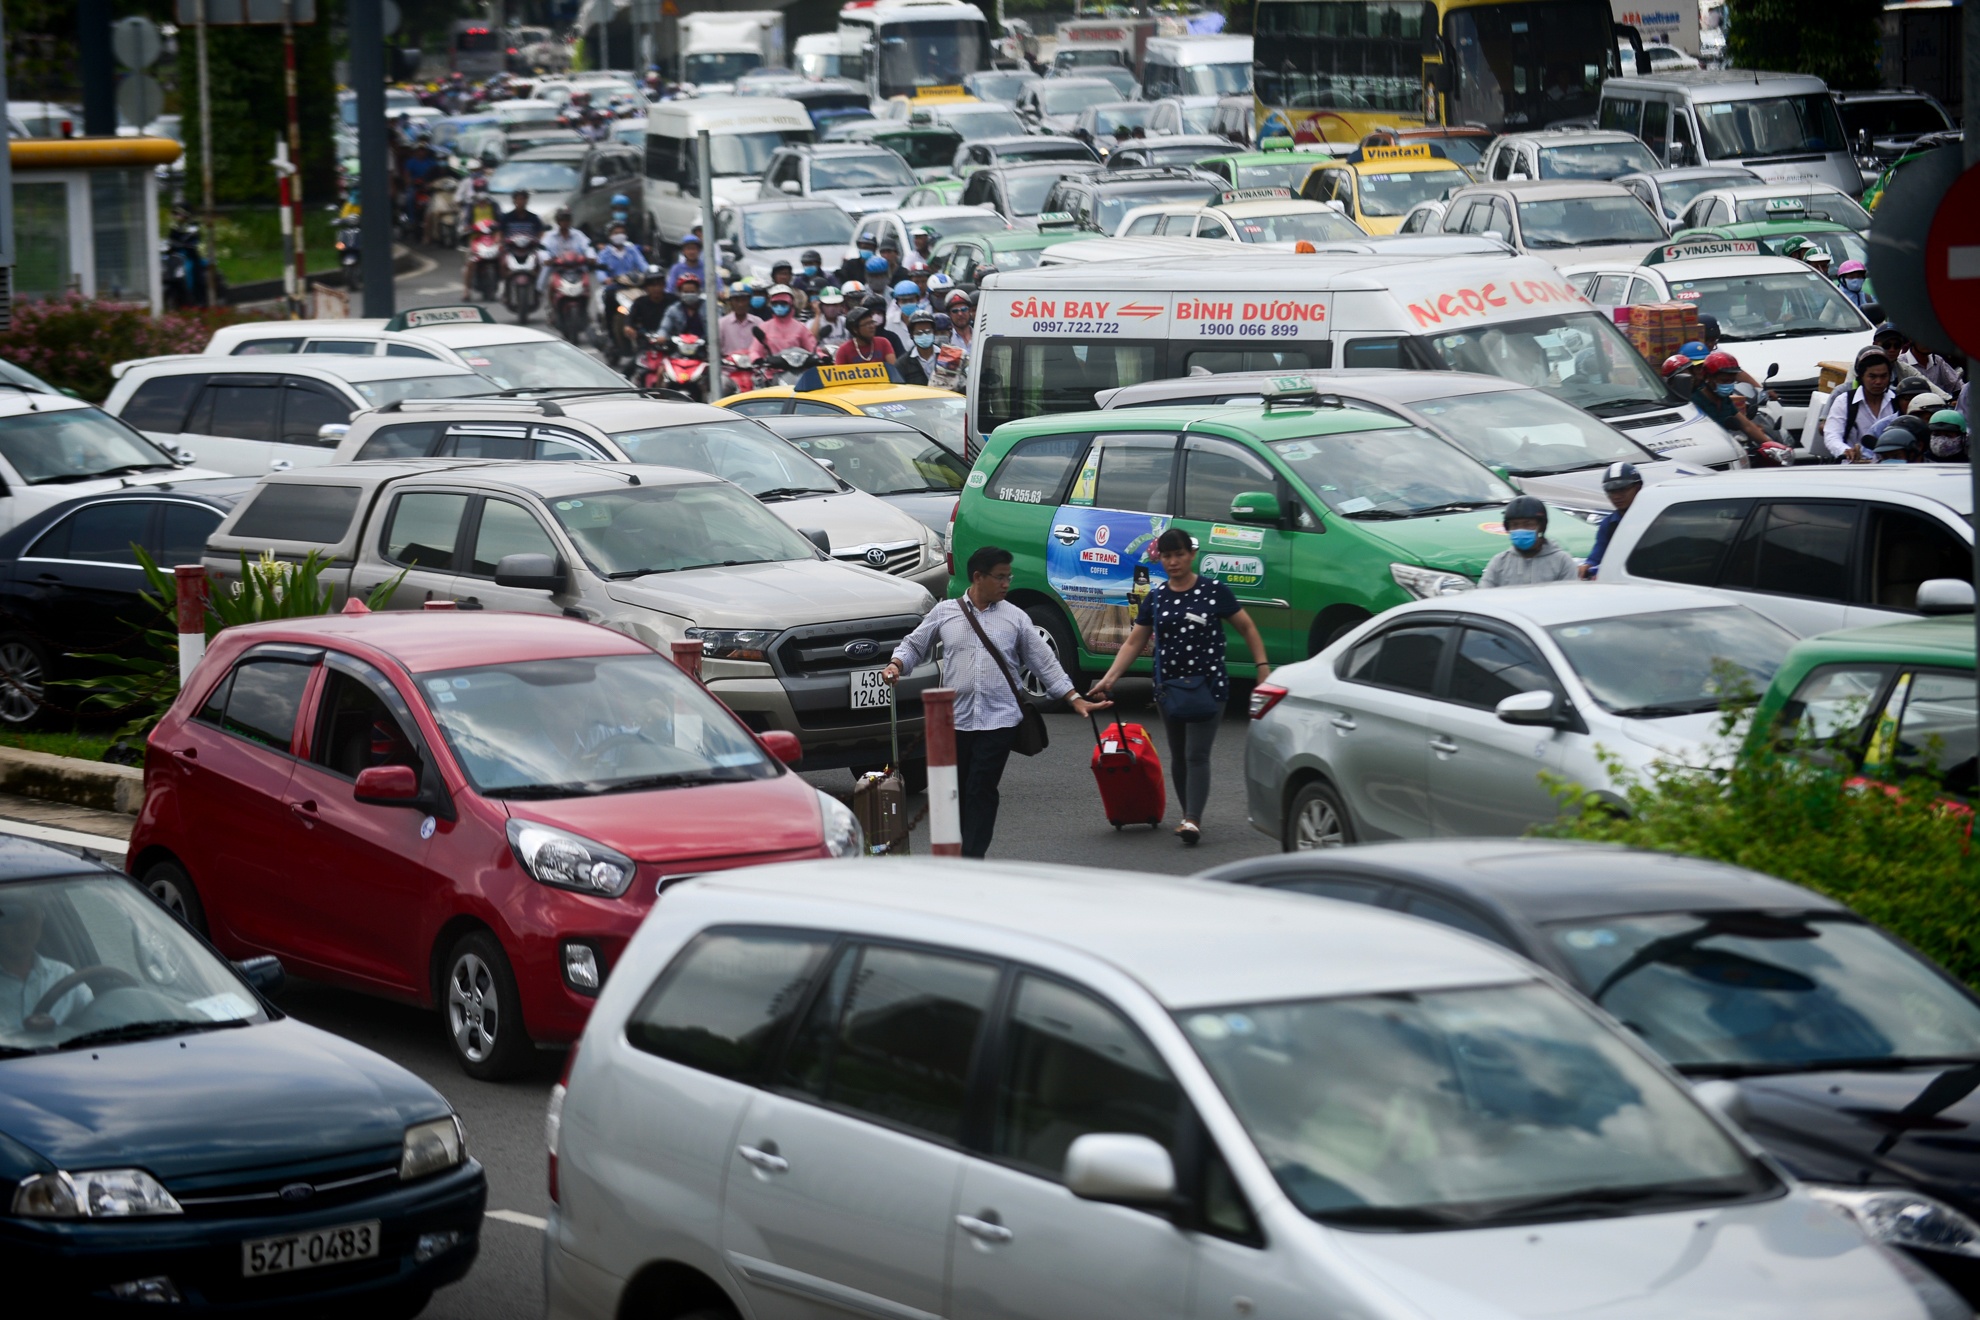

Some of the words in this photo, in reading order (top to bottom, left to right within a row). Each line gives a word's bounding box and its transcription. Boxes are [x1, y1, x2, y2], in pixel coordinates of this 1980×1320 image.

[1367, 146, 1425, 159] Vinataxi
[1237, 189, 1273, 200] VINASUN
[1274, 187, 1290, 197] TAXI
[1683, 243, 1732, 255] VINASUN
[1733, 242, 1756, 252] TAXI
[1010, 296, 1056, 318] SÂN
[1063, 301, 1110, 319] BAY
[1176, 298, 1233, 320] BÌNH
[1242, 300, 1326, 322] DƯƠNG
[1032, 321, 1119, 334] 0997.722.722
[1199, 323, 1234, 336] 1900
[1239, 323, 1266, 336] 066
[1271, 324, 1299, 337] 899
[822, 364, 885, 382] Vinataxi
[999, 487, 1042, 504] 51F-355.63
[1095, 552, 1118, 563] TRANG
[1090, 566, 1109, 576] COFFEE
[1227, 574, 1257, 583] GROUP
[854, 643, 874, 655] Ford
[250, 1226, 372, 1274] 52T-0483
